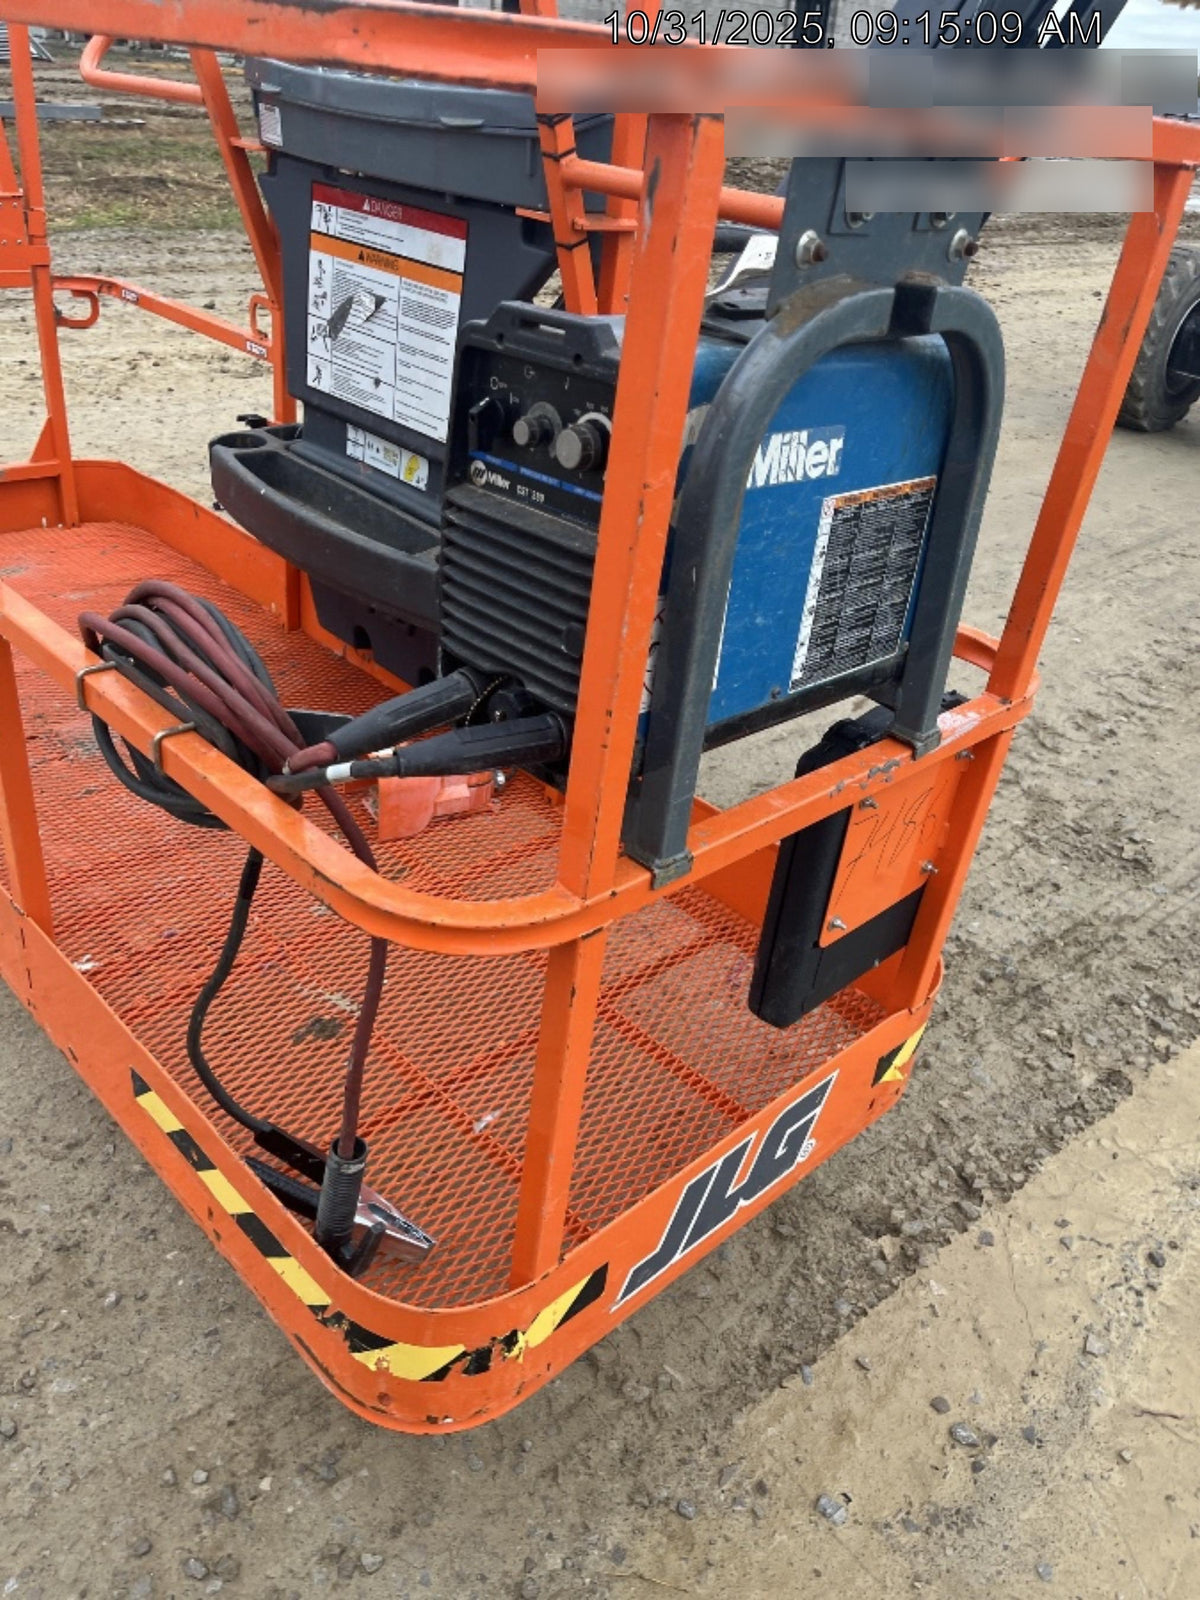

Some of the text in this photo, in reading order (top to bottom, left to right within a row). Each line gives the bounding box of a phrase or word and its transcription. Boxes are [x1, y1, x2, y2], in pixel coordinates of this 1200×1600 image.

[370, 200, 402, 220] DANGER
[366, 252, 399, 271] WARNING
[746, 430, 844, 489] Miller
[487, 470, 511, 490] Miller
[609, 1069, 840, 1314] JLG
